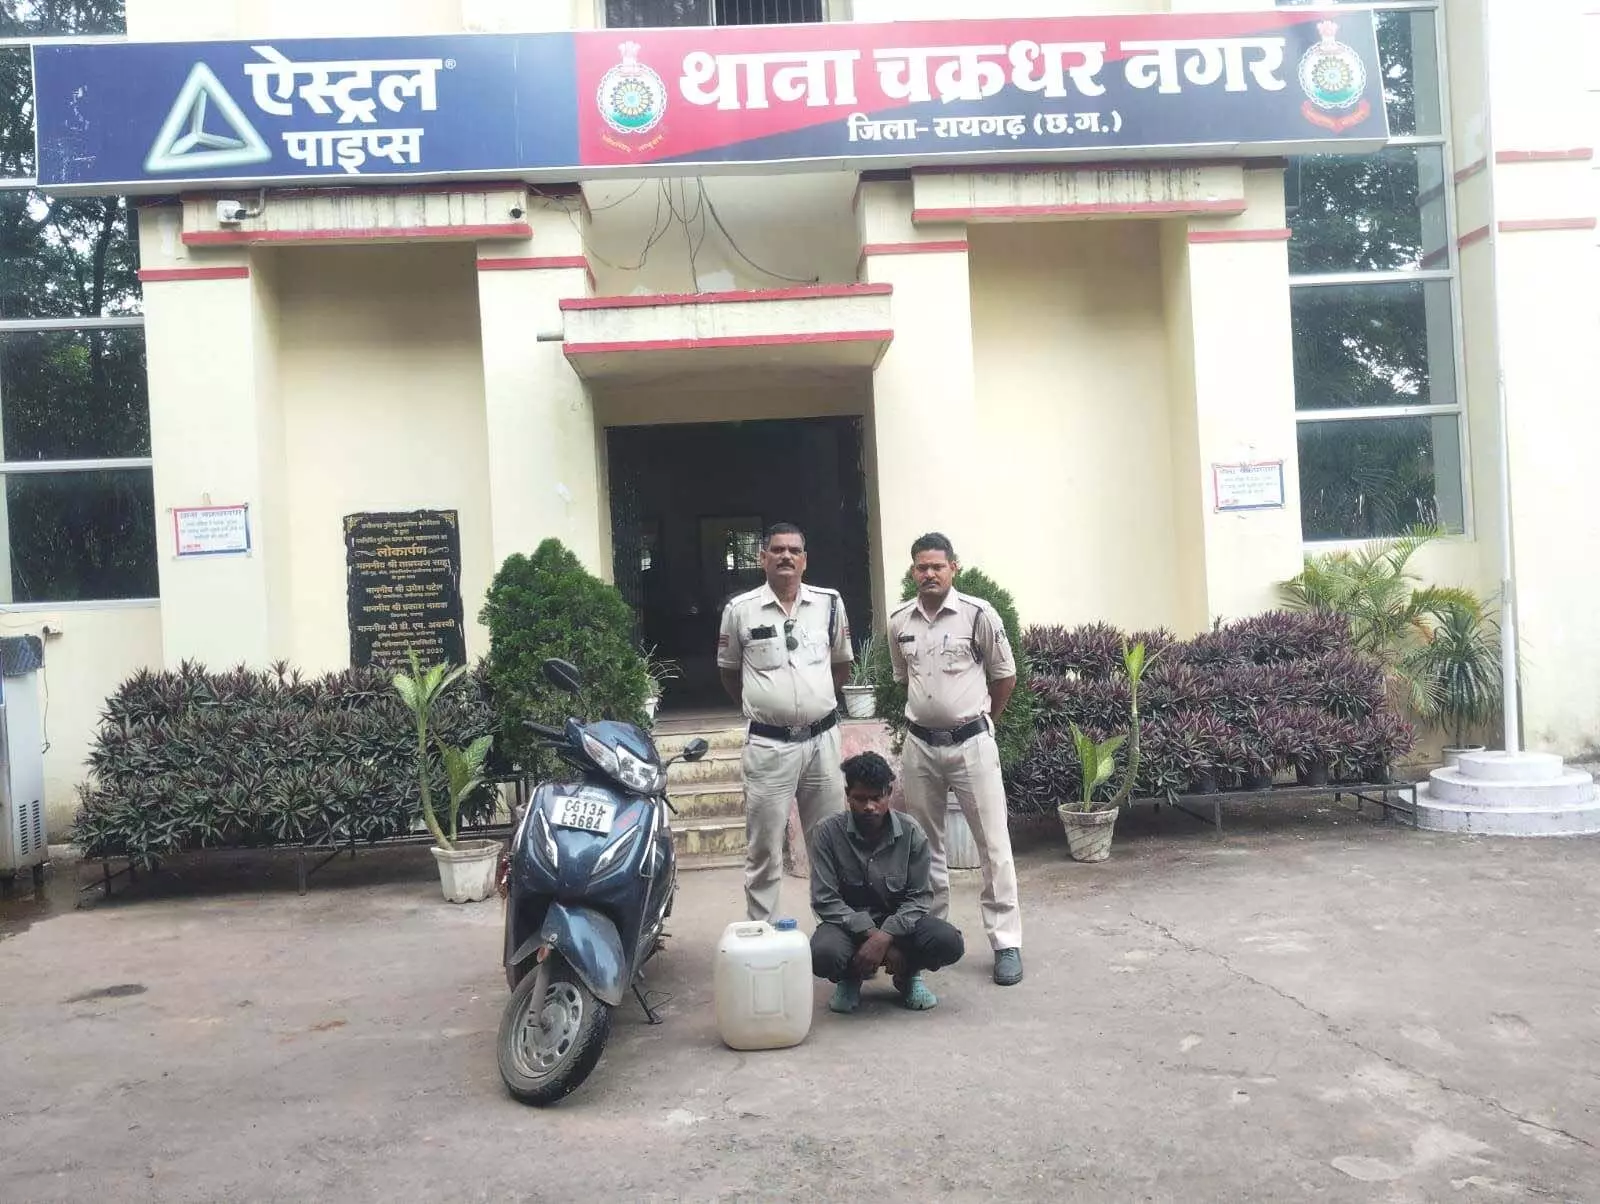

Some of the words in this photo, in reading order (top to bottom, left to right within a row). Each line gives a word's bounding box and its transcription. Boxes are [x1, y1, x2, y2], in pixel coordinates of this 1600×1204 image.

[243, 45, 443, 122] ऐस्ट्रल
[679, 50, 860, 111] थाना
[873, 40, 1105, 104] चक्रधर
[1119, 37, 1286, 94] नगर
[1033, 110, 1122, 135] (छ.ग.)
[283, 127, 424, 174] पाइप्स
[376, 543, 427, 557] लोकार्पण
[561, 812, 602, 830] L3684
